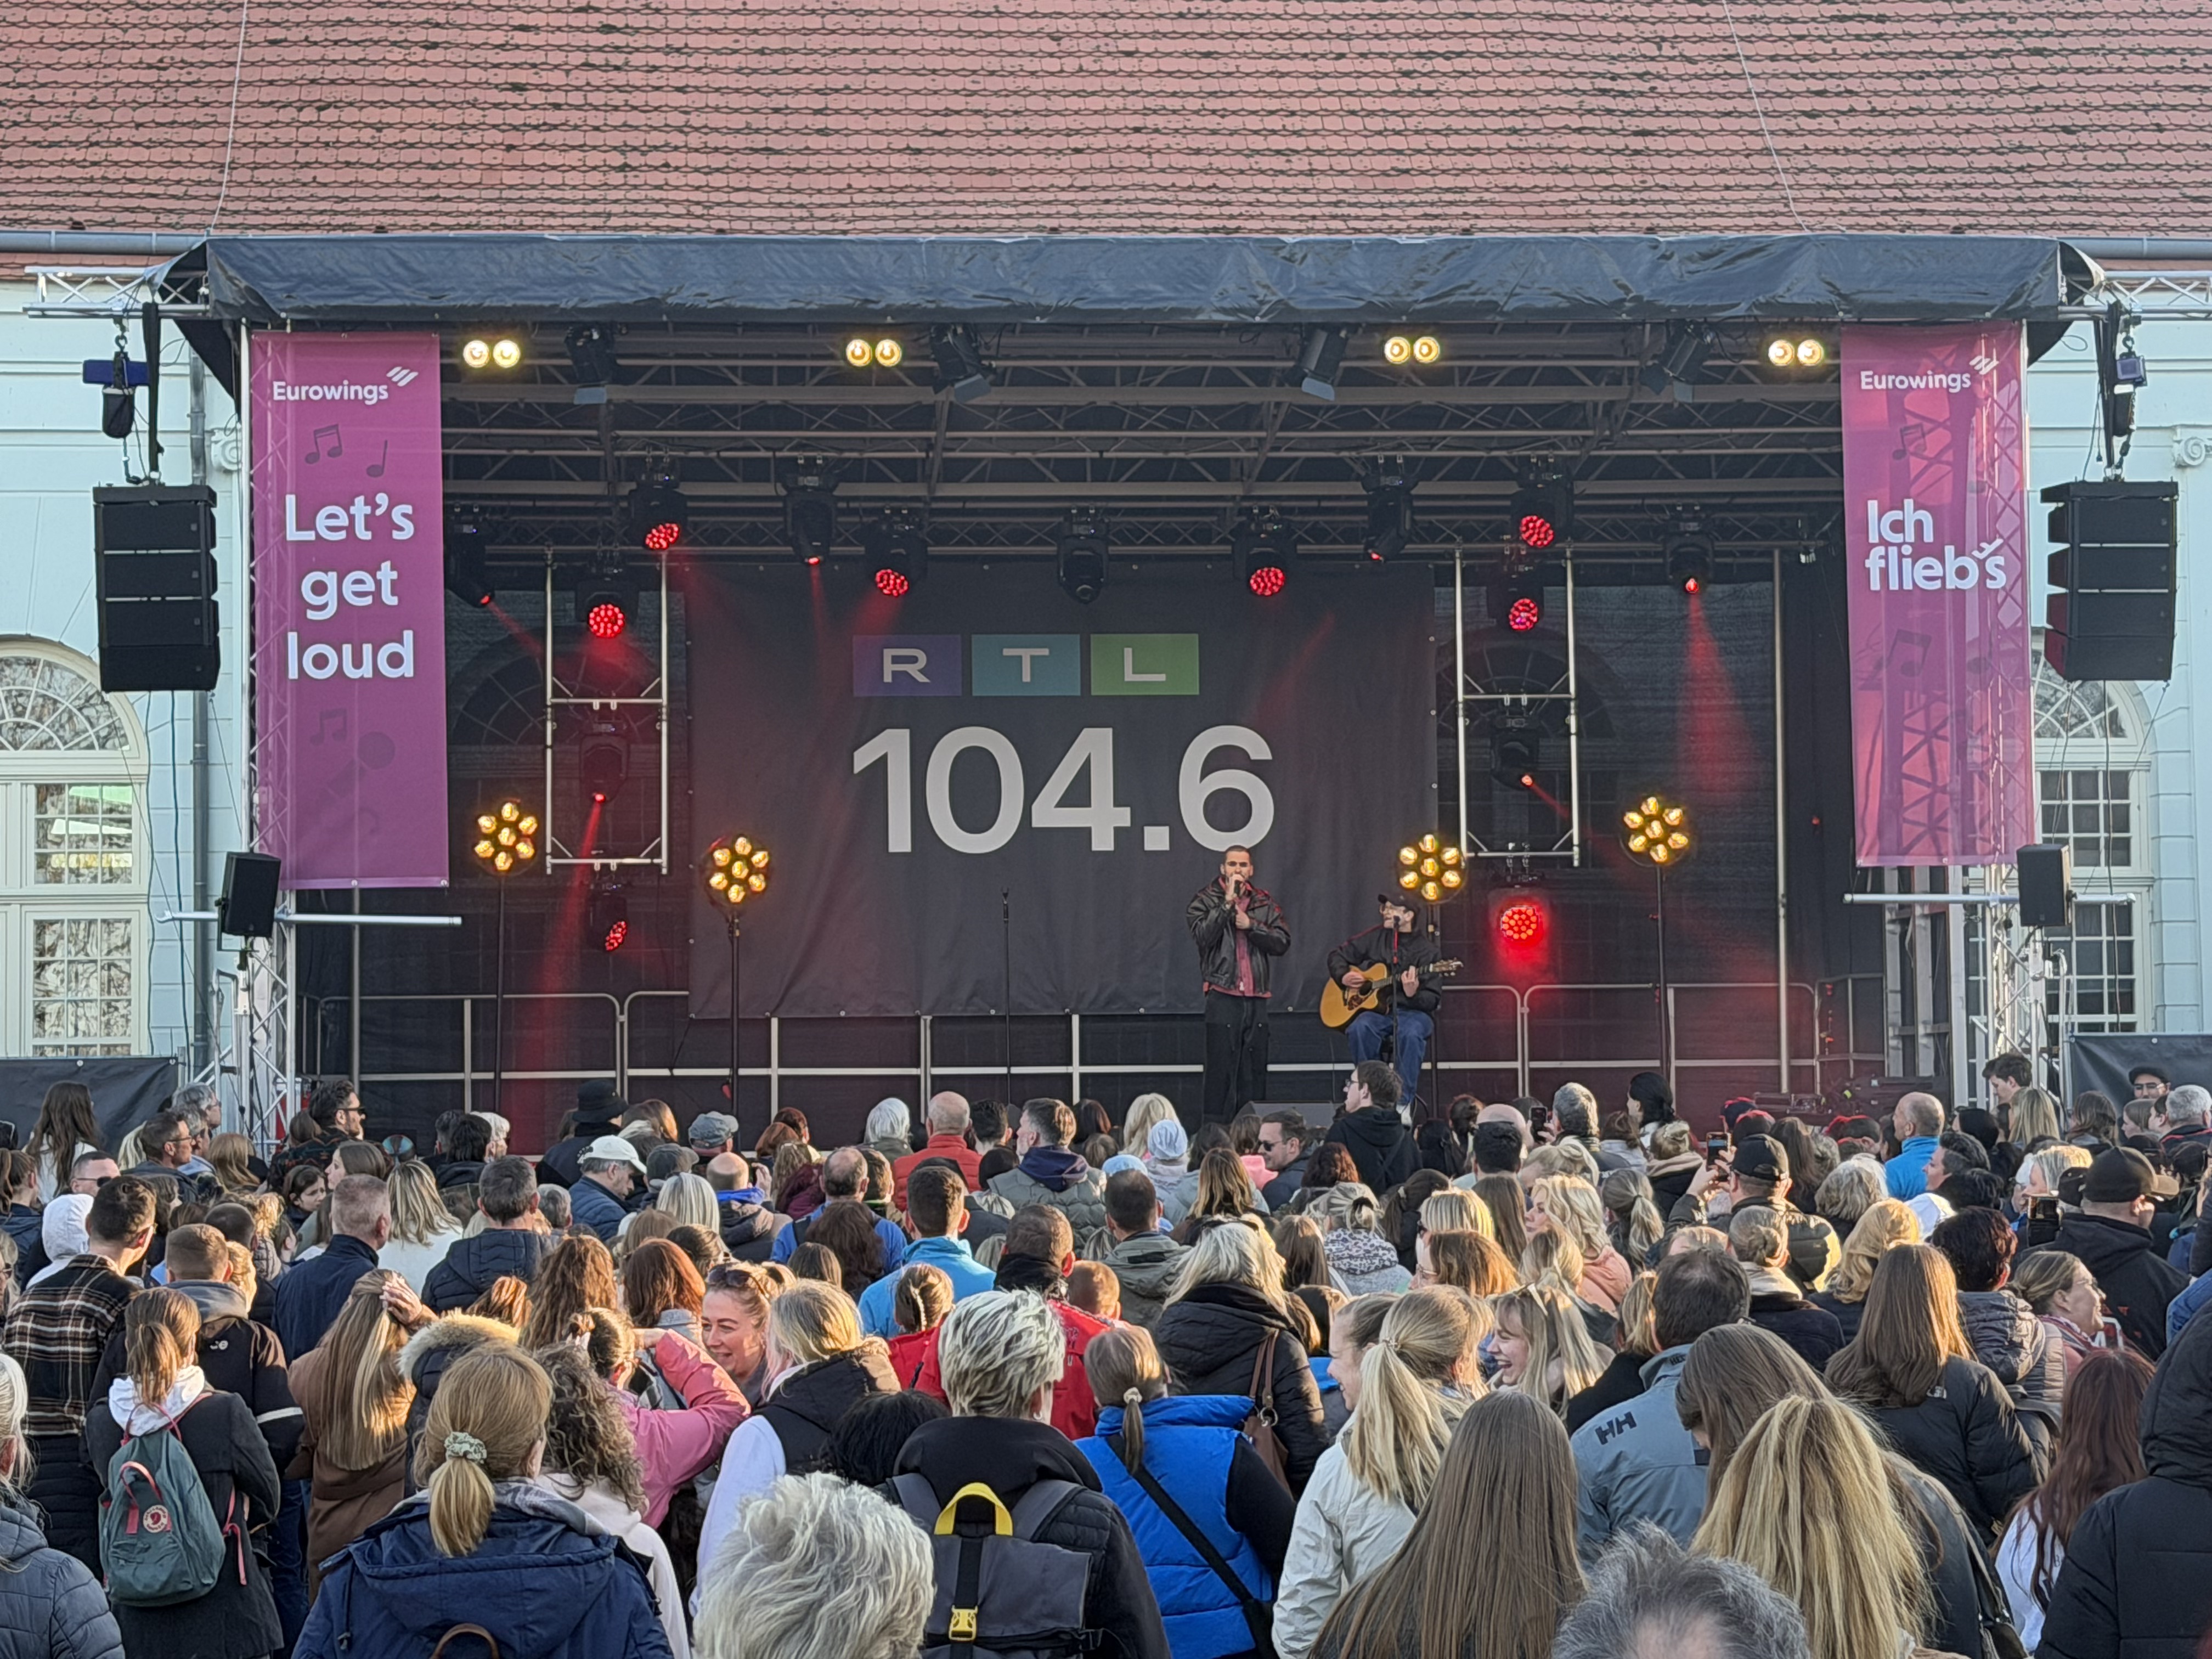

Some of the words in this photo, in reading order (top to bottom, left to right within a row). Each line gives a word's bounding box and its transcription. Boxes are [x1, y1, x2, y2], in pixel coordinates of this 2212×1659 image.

[273, 380, 388, 405] Eurowings
[1860, 370, 1972, 393] Eurowings
[285, 493, 414, 541] Let's
[1867, 499, 1934, 543] Ich
[301, 560, 398, 620] get
[287, 630, 414, 680] loud
[853, 725, 1274, 854] 104.6
[1595, 1411, 1637, 1445] HH
